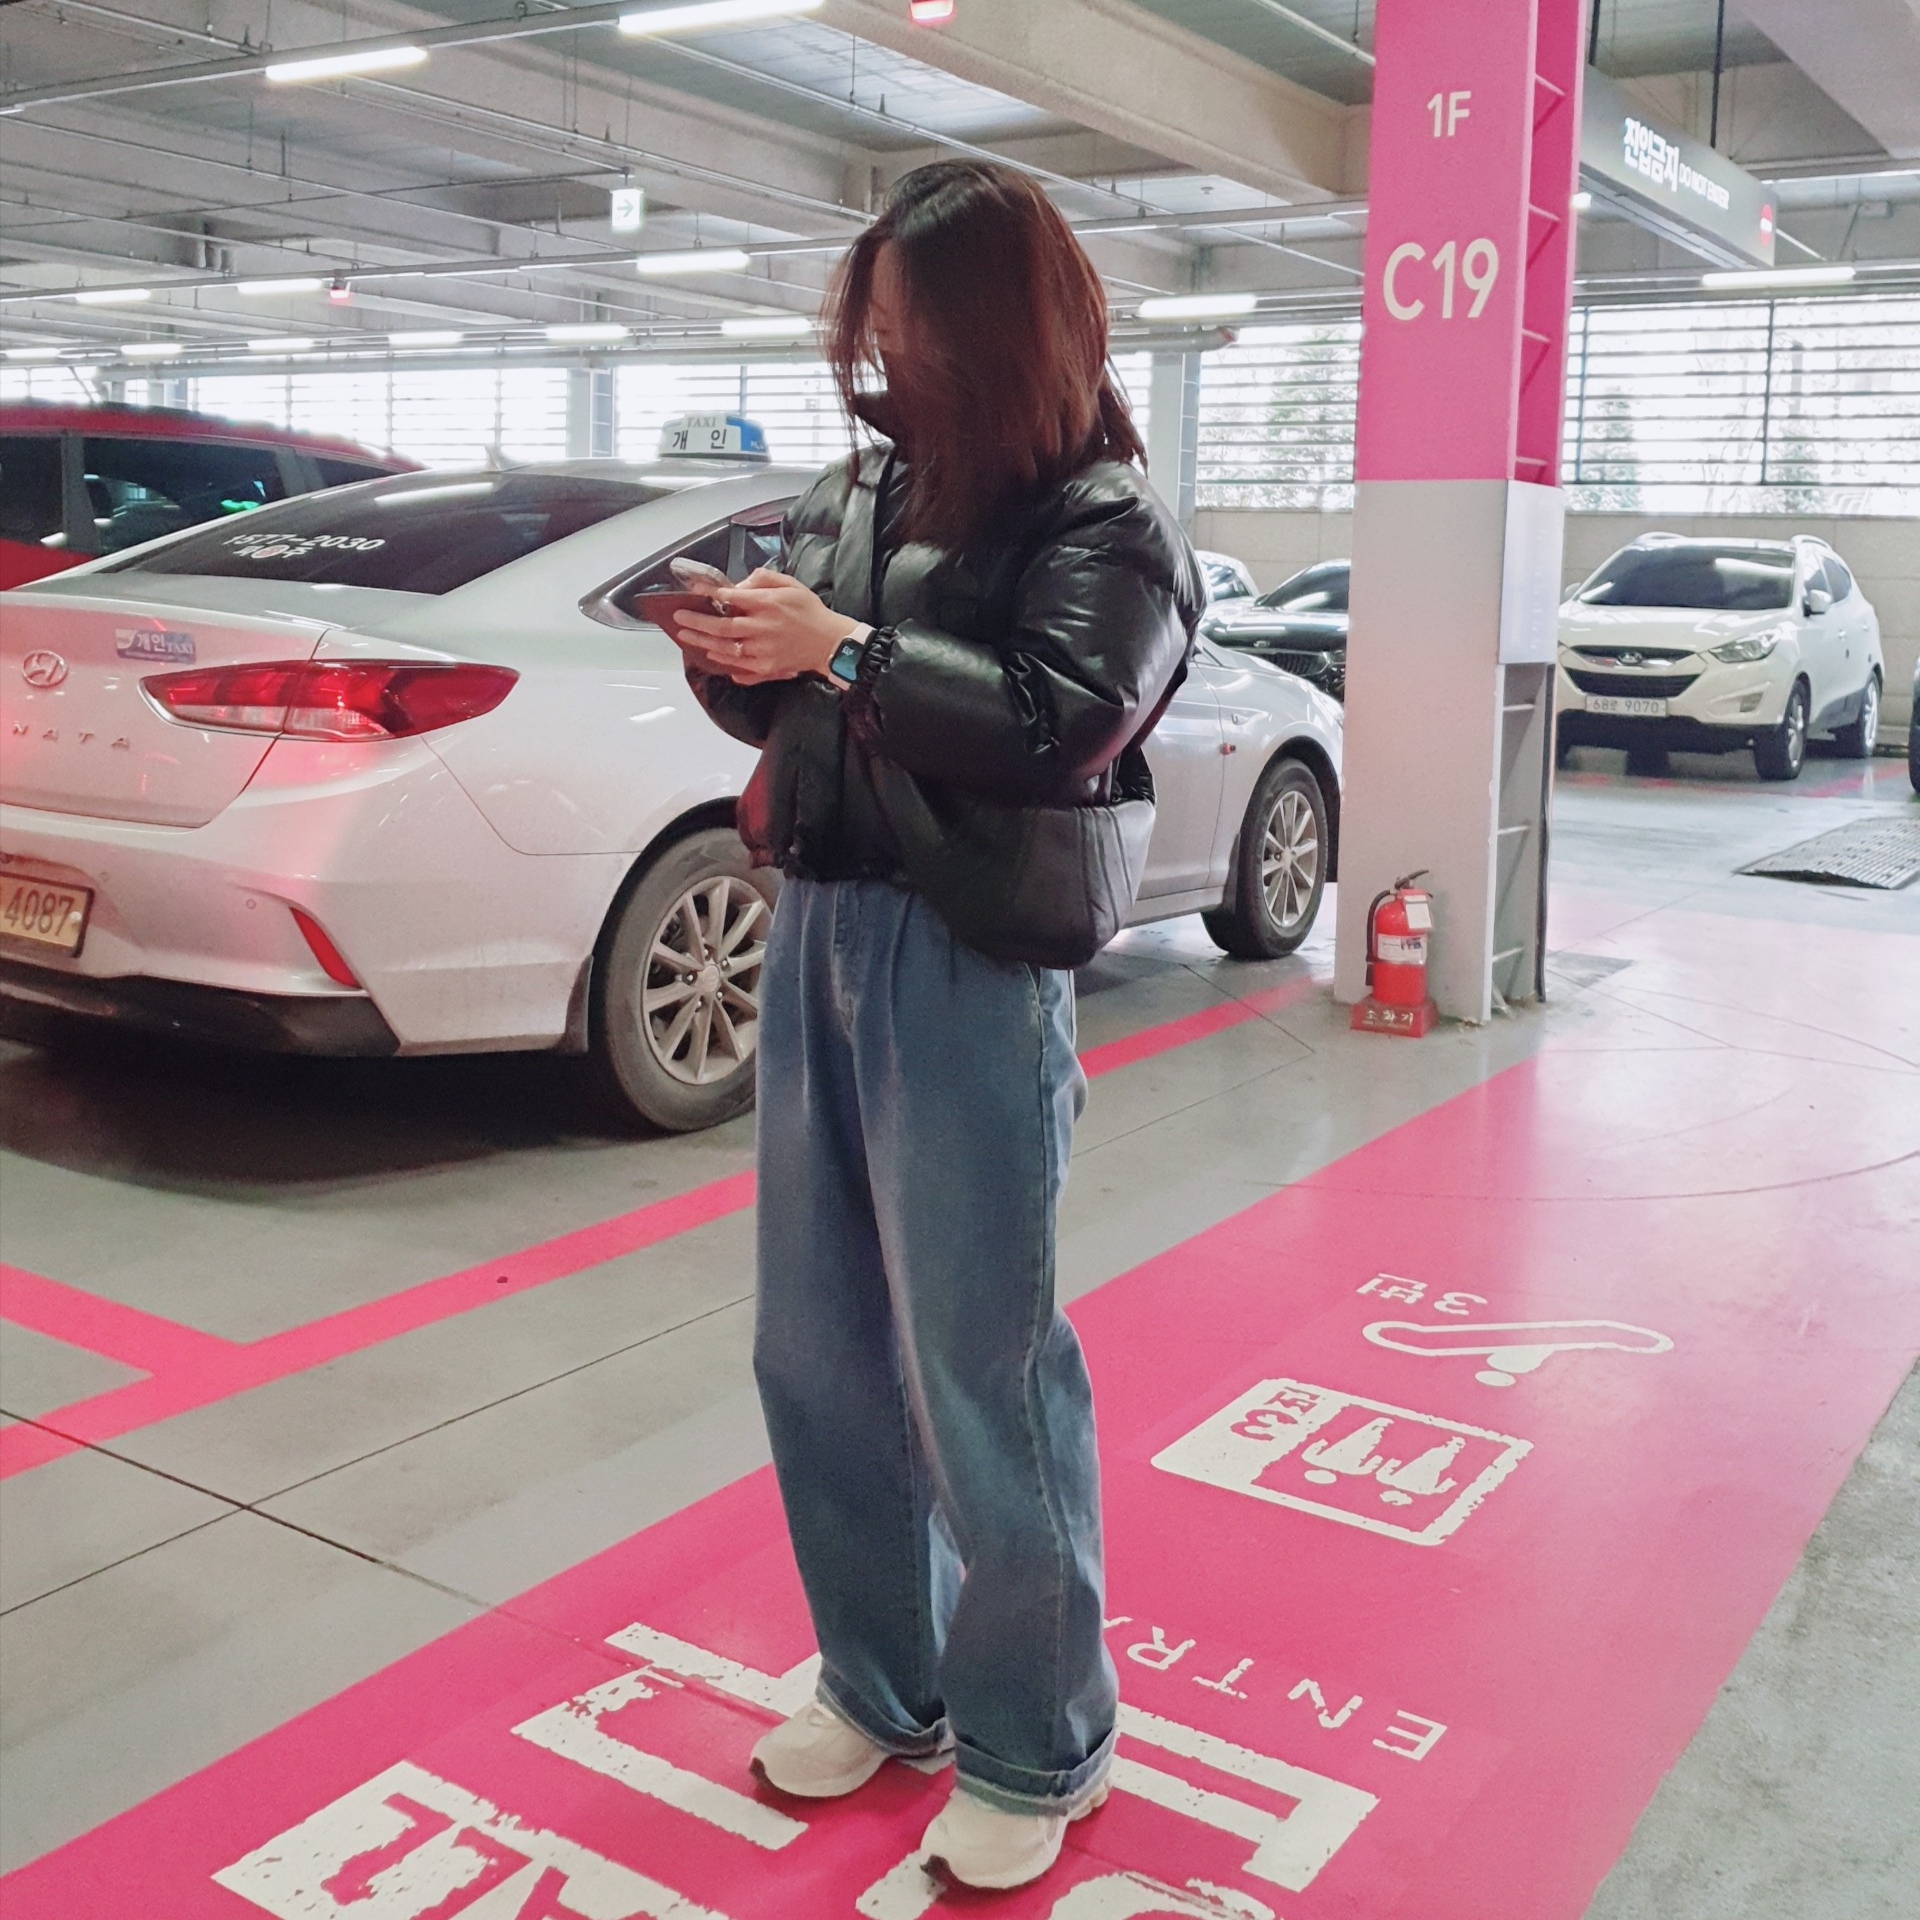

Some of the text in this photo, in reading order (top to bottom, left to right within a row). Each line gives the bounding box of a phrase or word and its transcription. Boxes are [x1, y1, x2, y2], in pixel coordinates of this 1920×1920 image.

[1427, 90, 1471, 137] 1F
[1623, 117, 1680, 192] 진입금지
[1679, 162, 1729, 210] DO NOT ENTER
[1383, 238, 1499, 320] C19
[687, 416, 717, 428] TAXI
[222, 533, 386, 551] 1577-2030
[1624, 699, 1659, 714] 9070
[4, 886, 76, 937] 4087
[1102, 1616, 1448, 1761] ENTR
